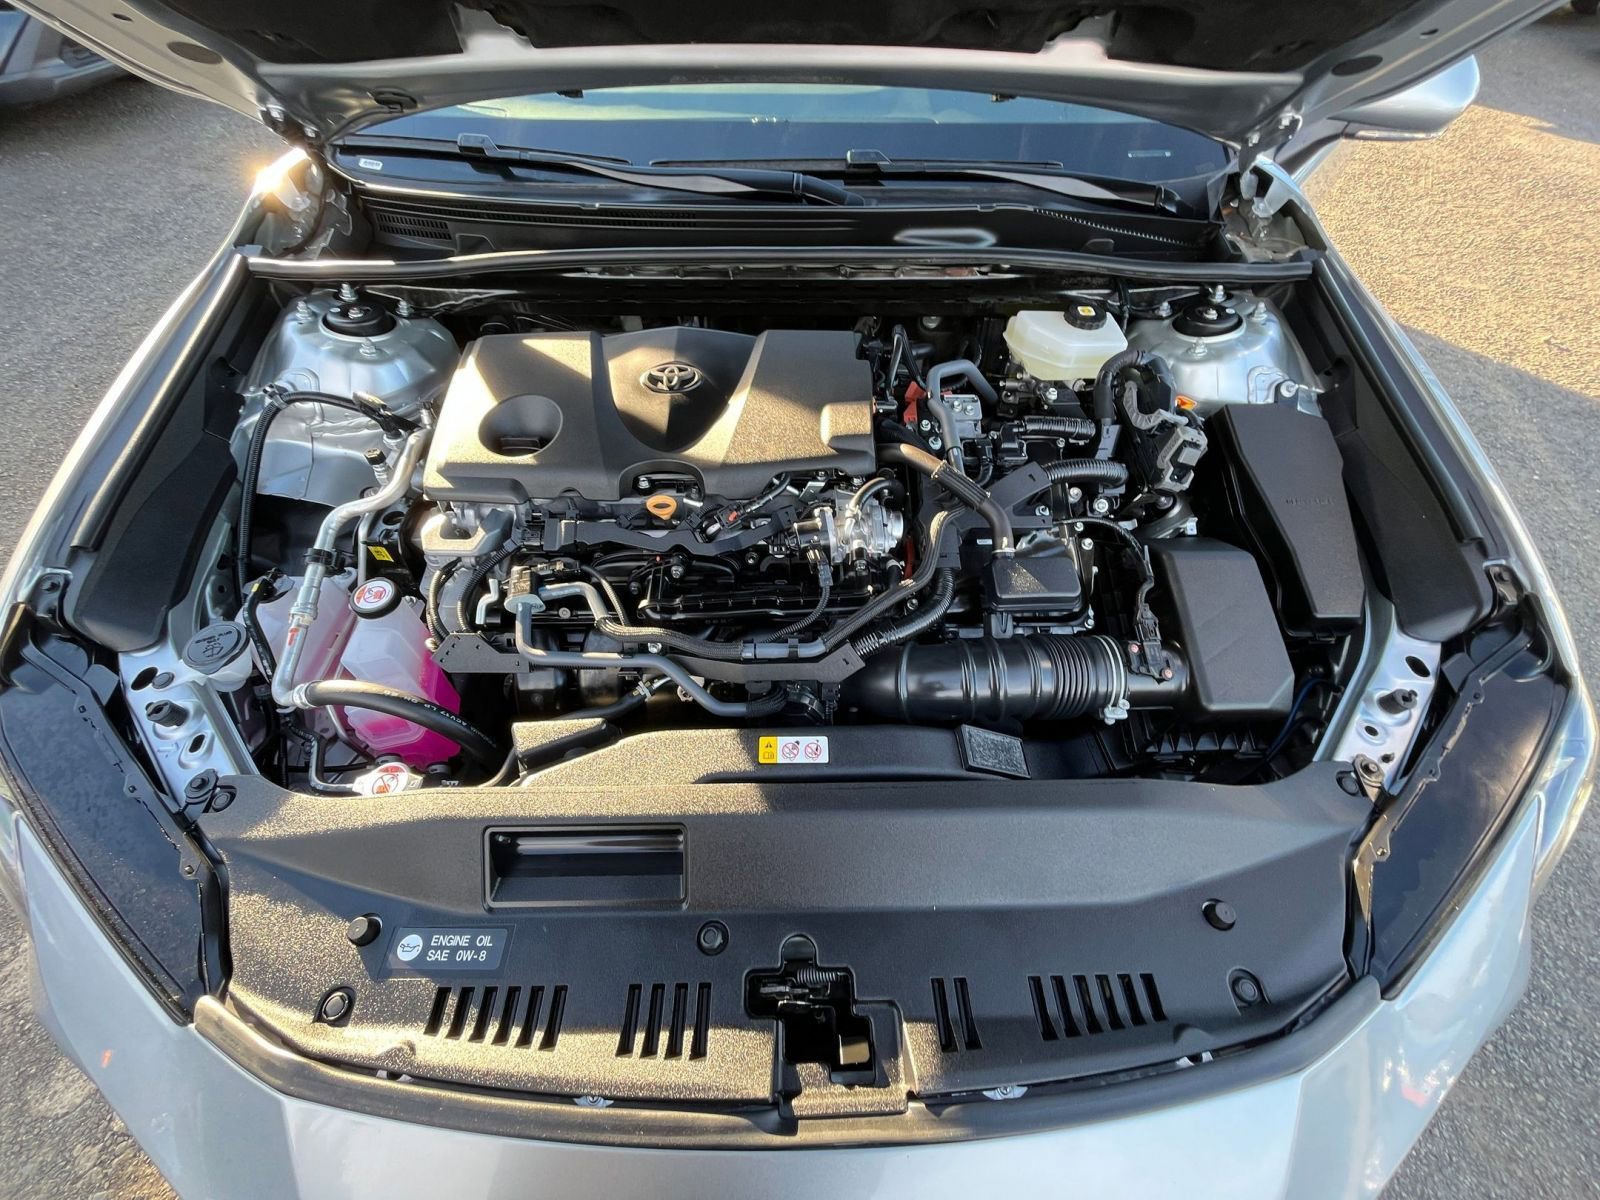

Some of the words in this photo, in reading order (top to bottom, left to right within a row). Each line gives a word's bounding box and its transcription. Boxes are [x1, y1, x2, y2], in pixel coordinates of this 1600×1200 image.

[430, 935, 471, 946] ENGINE
[476, 935, 493, 947] OIL
[426, 950, 450, 961] SAE
[456, 950, 487, 961] 0W-8
